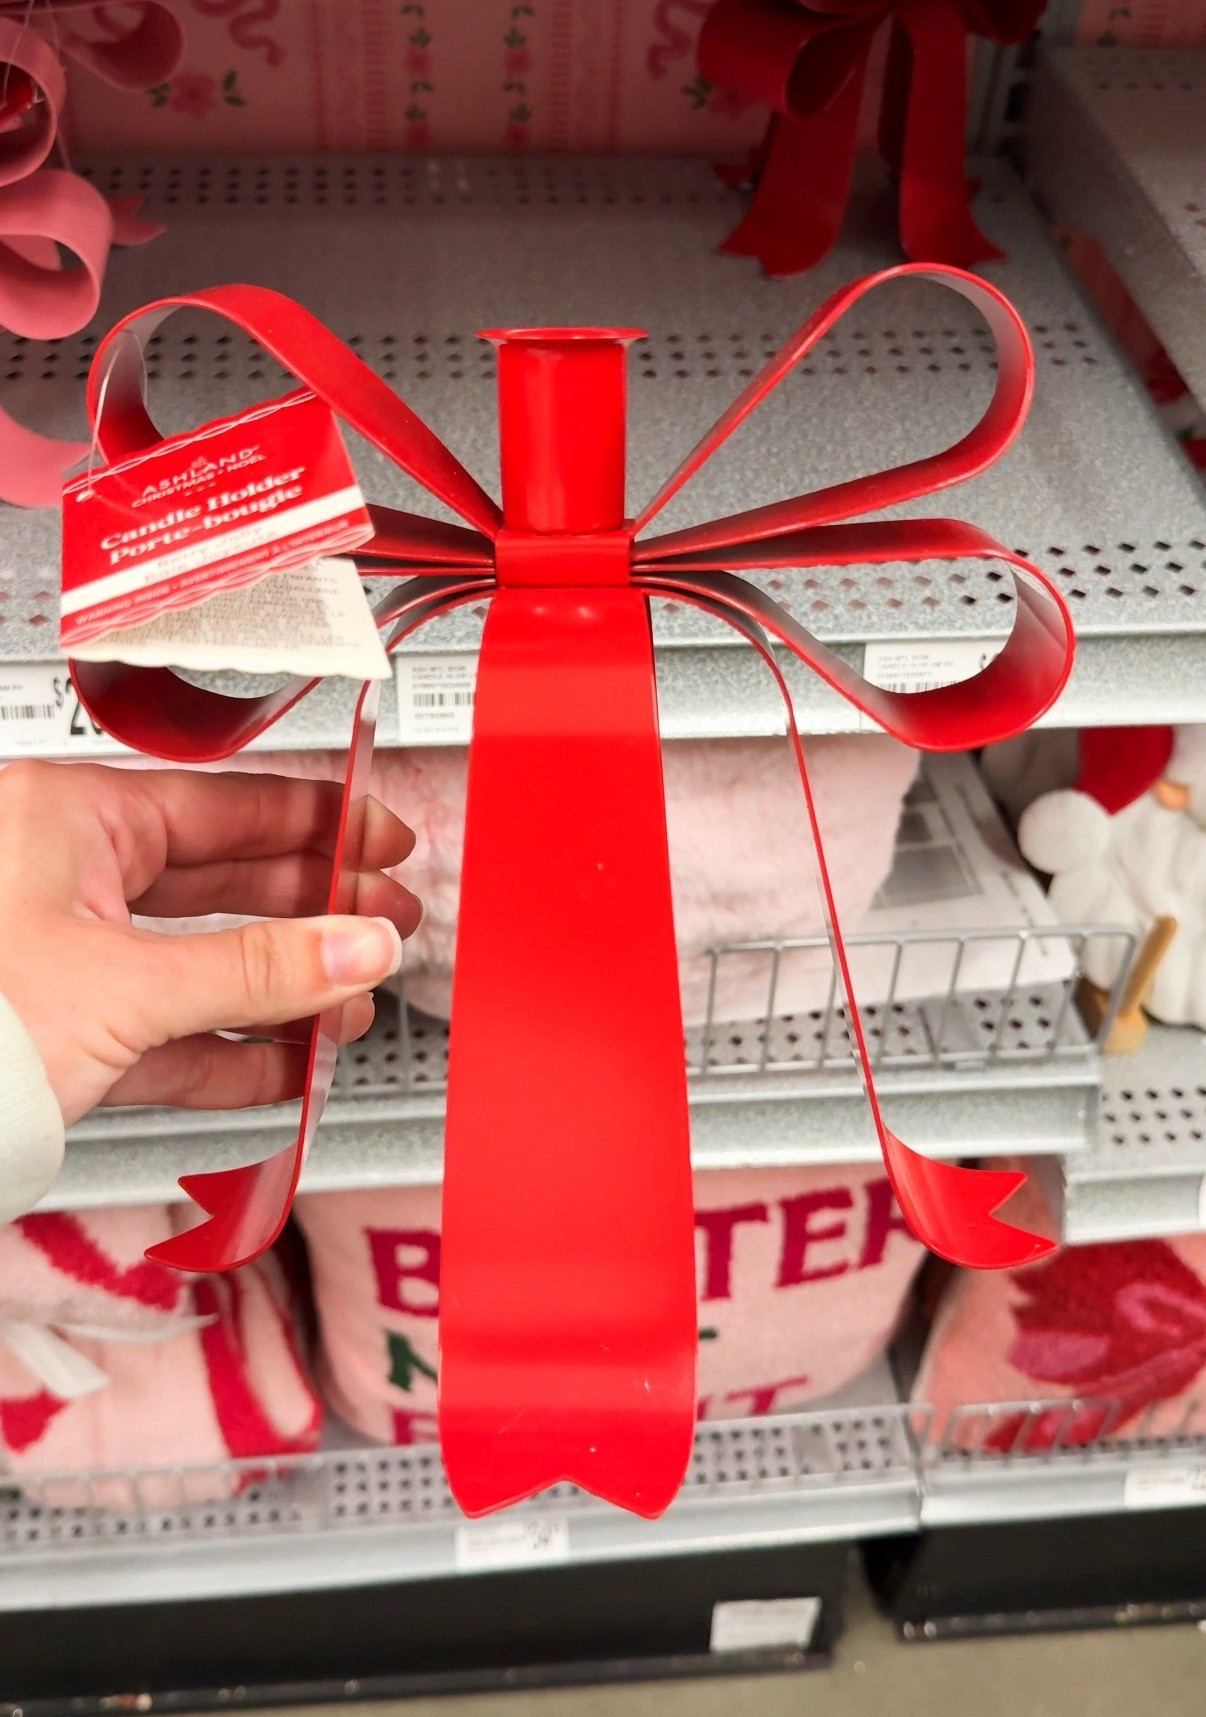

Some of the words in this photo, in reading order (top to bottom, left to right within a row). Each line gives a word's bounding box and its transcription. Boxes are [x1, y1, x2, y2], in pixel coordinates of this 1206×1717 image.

[131, 471, 215, 508] CHRISTMAS
[142, 447, 254, 497] ASHLAND
[101, 505, 201, 550] Candle
[207, 466, 305, 511] Holder
[110, 486, 302, 566] Porte-bougie
[75, 598, 133, 625] WARNING
